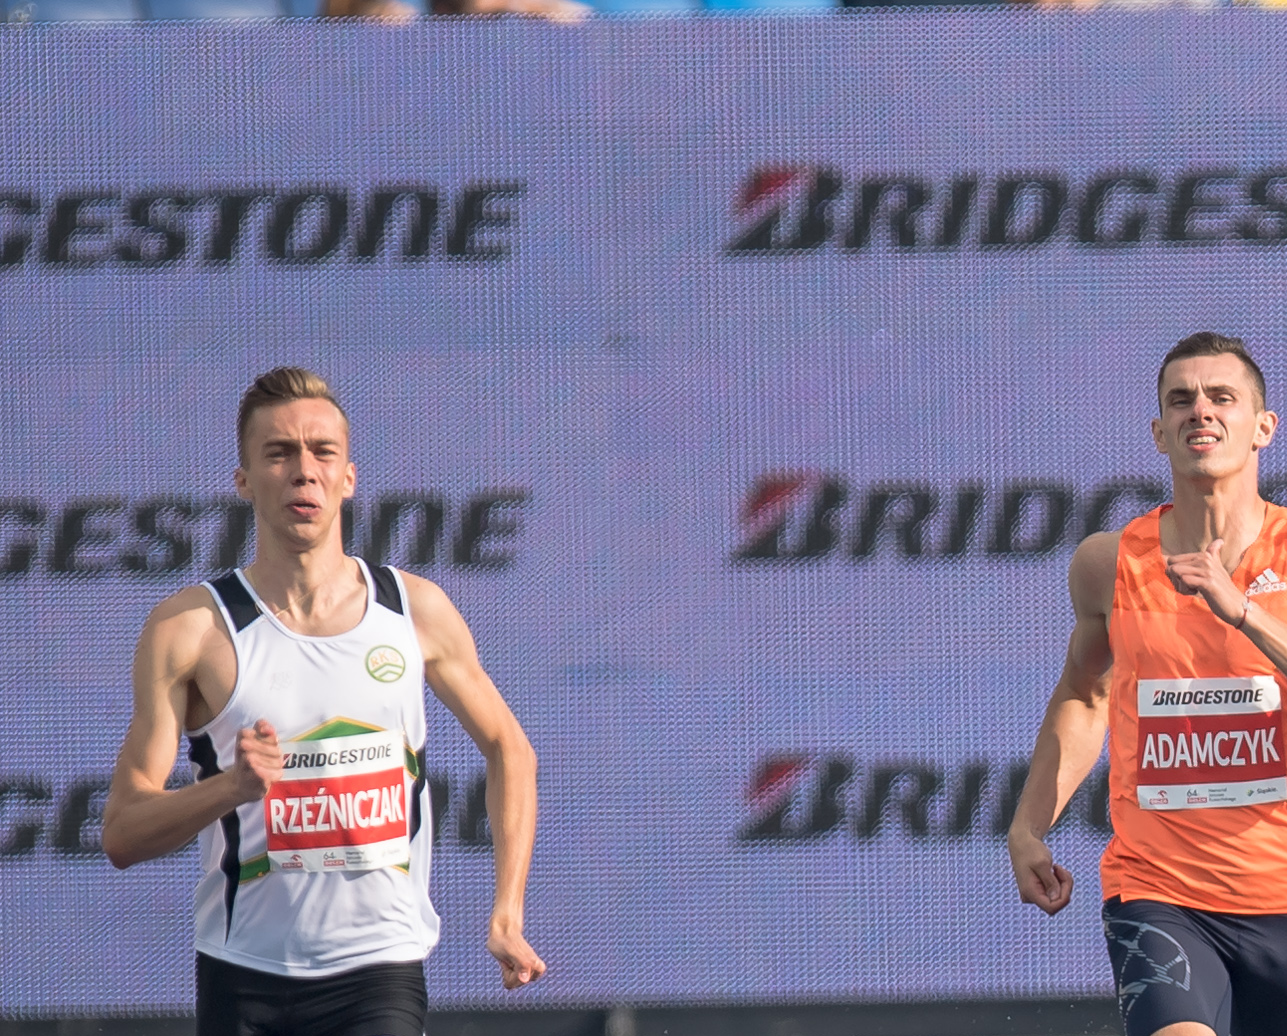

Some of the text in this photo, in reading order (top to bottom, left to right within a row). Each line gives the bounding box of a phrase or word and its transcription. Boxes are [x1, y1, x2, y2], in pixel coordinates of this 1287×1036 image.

[1153, 688, 1264, 706] BRIDGESTONE
[282, 743, 392, 770] BRIDGESTONE
[1141, 727, 1281, 769] ADAMCZYK
[270, 784, 405, 835] RZEŹNICZAK
